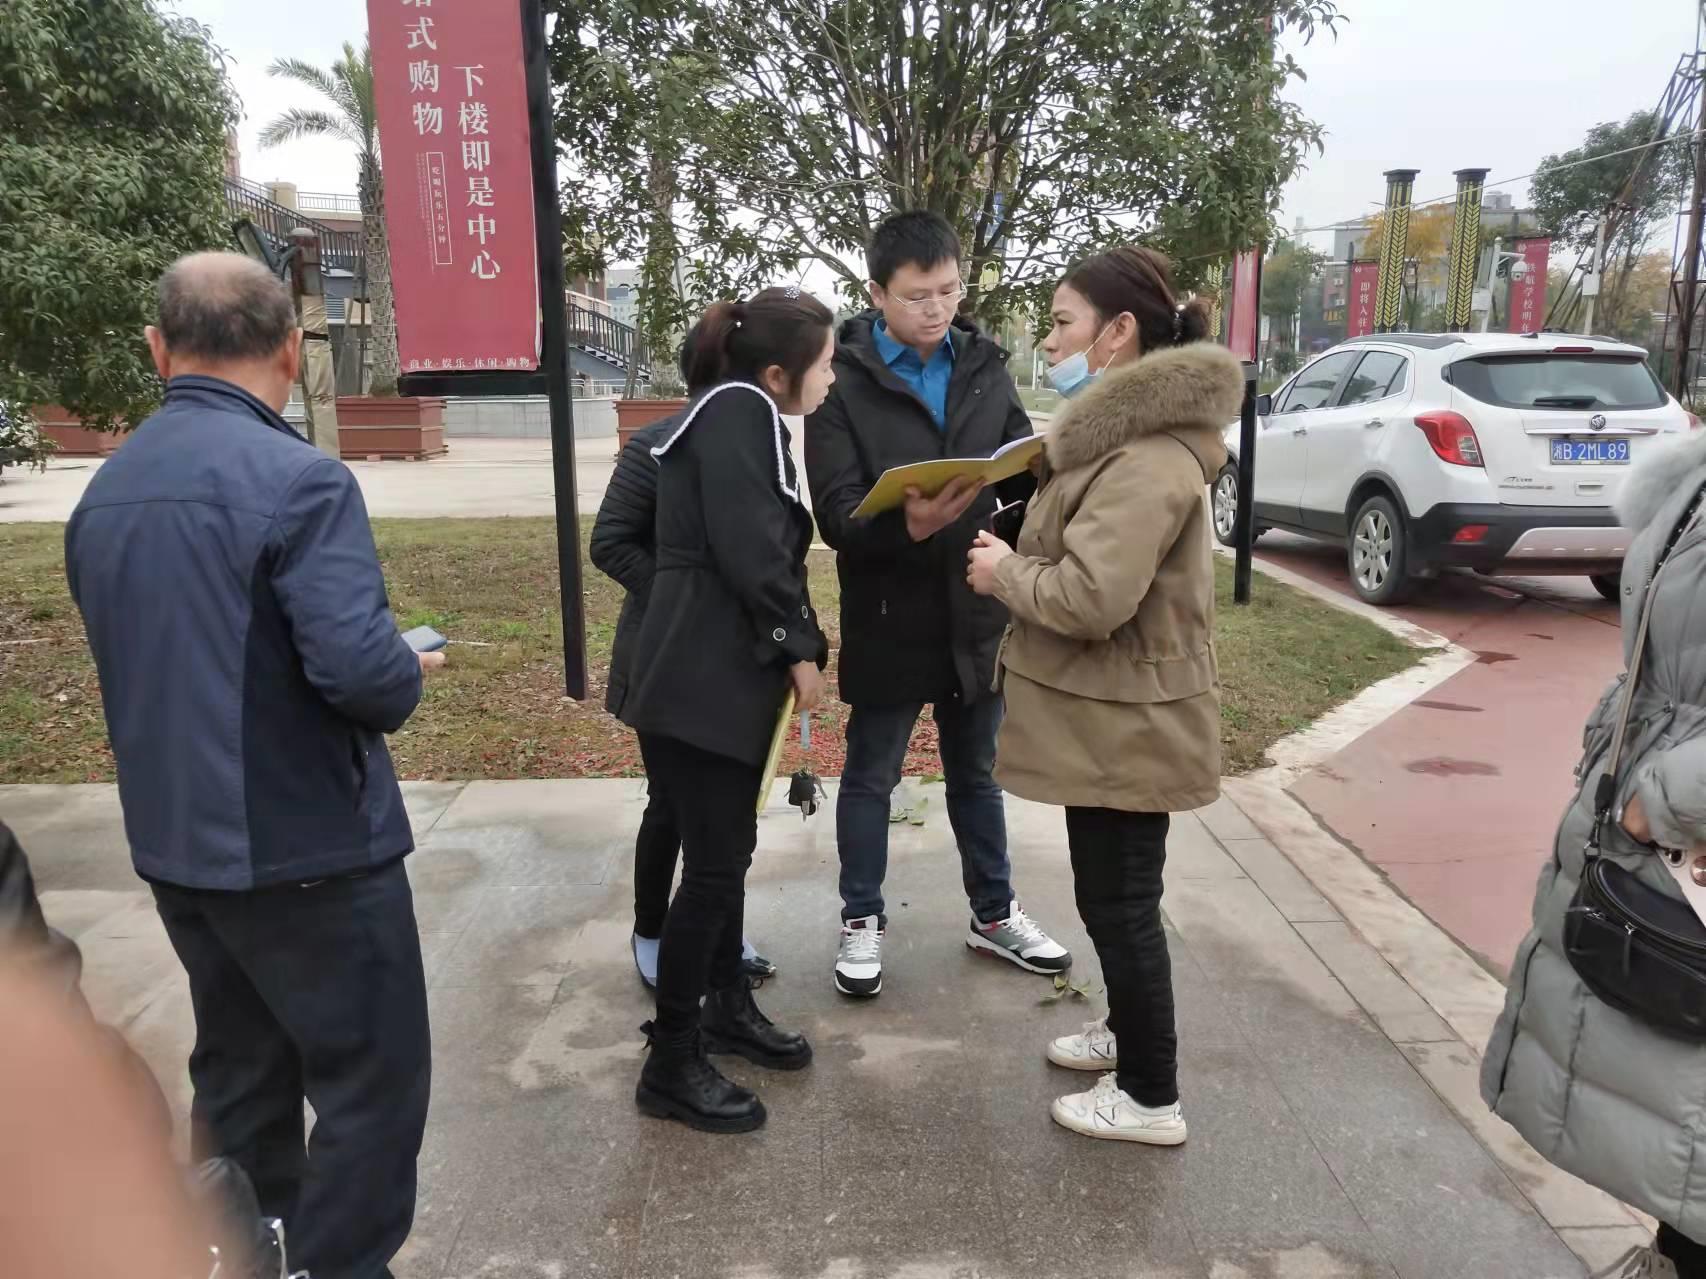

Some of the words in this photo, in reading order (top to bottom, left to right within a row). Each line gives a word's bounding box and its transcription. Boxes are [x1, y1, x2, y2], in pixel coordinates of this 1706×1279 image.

[401, 0, 443, 135] 式购物
[453, 64, 501, 279] 下楼即是中心
